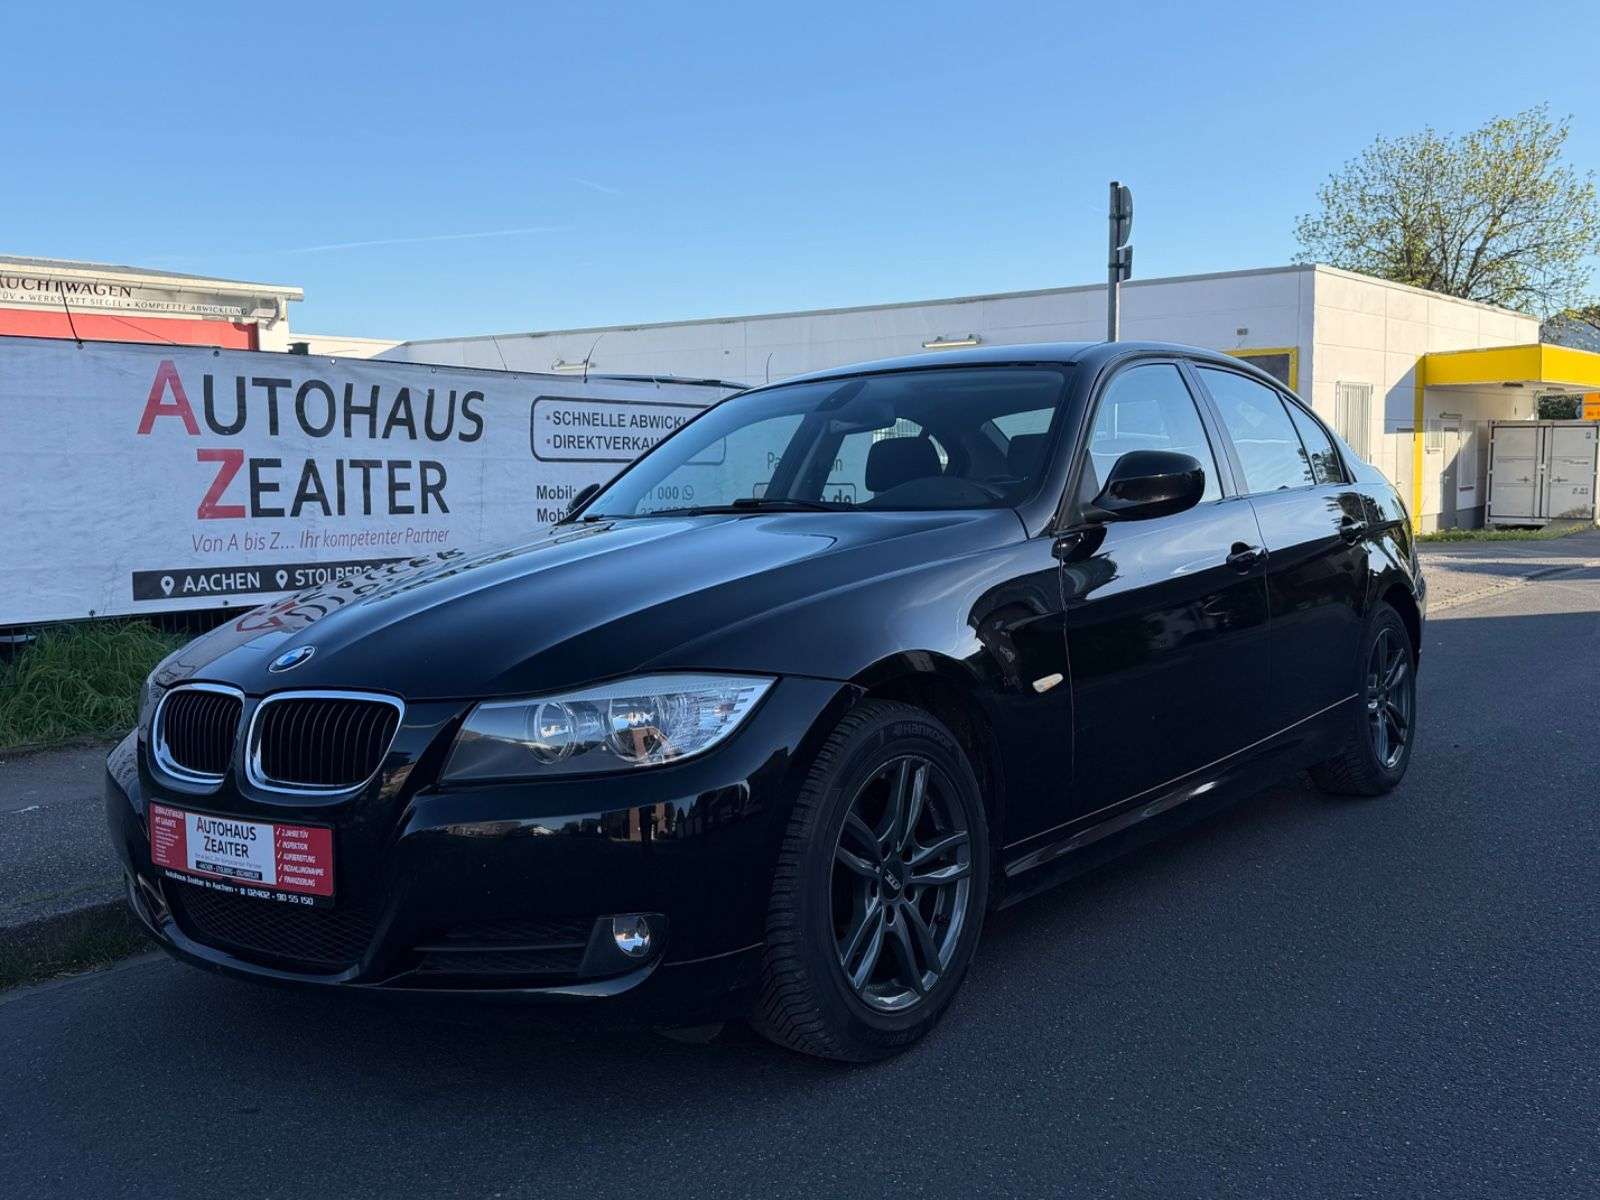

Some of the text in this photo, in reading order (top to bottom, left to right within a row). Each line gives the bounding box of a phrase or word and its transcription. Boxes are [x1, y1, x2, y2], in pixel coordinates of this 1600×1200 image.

[28, 294, 85, 305] WERKSTATT
[90, 297, 122, 307] SIEGEL
[135, 301, 187, 312] KOMPLETTE
[191, 303, 248, 315] ABWICKLUNG
[137, 360, 485, 443] AUTOHAUS
[552, 411, 627, 428] SCHNELLE
[197, 448, 450, 520] ZEAITER
[657, 486, 679, 500] 000
[537, 508, 569, 523] Mobi
[192, 527, 449, 553] Von A bis Z... Ihr kompetenter Partner
[182, 571, 261, 593] AACHEN
[196, 817, 257, 841] AUTOHAUS
[203, 836, 250, 858] ZEAITER
